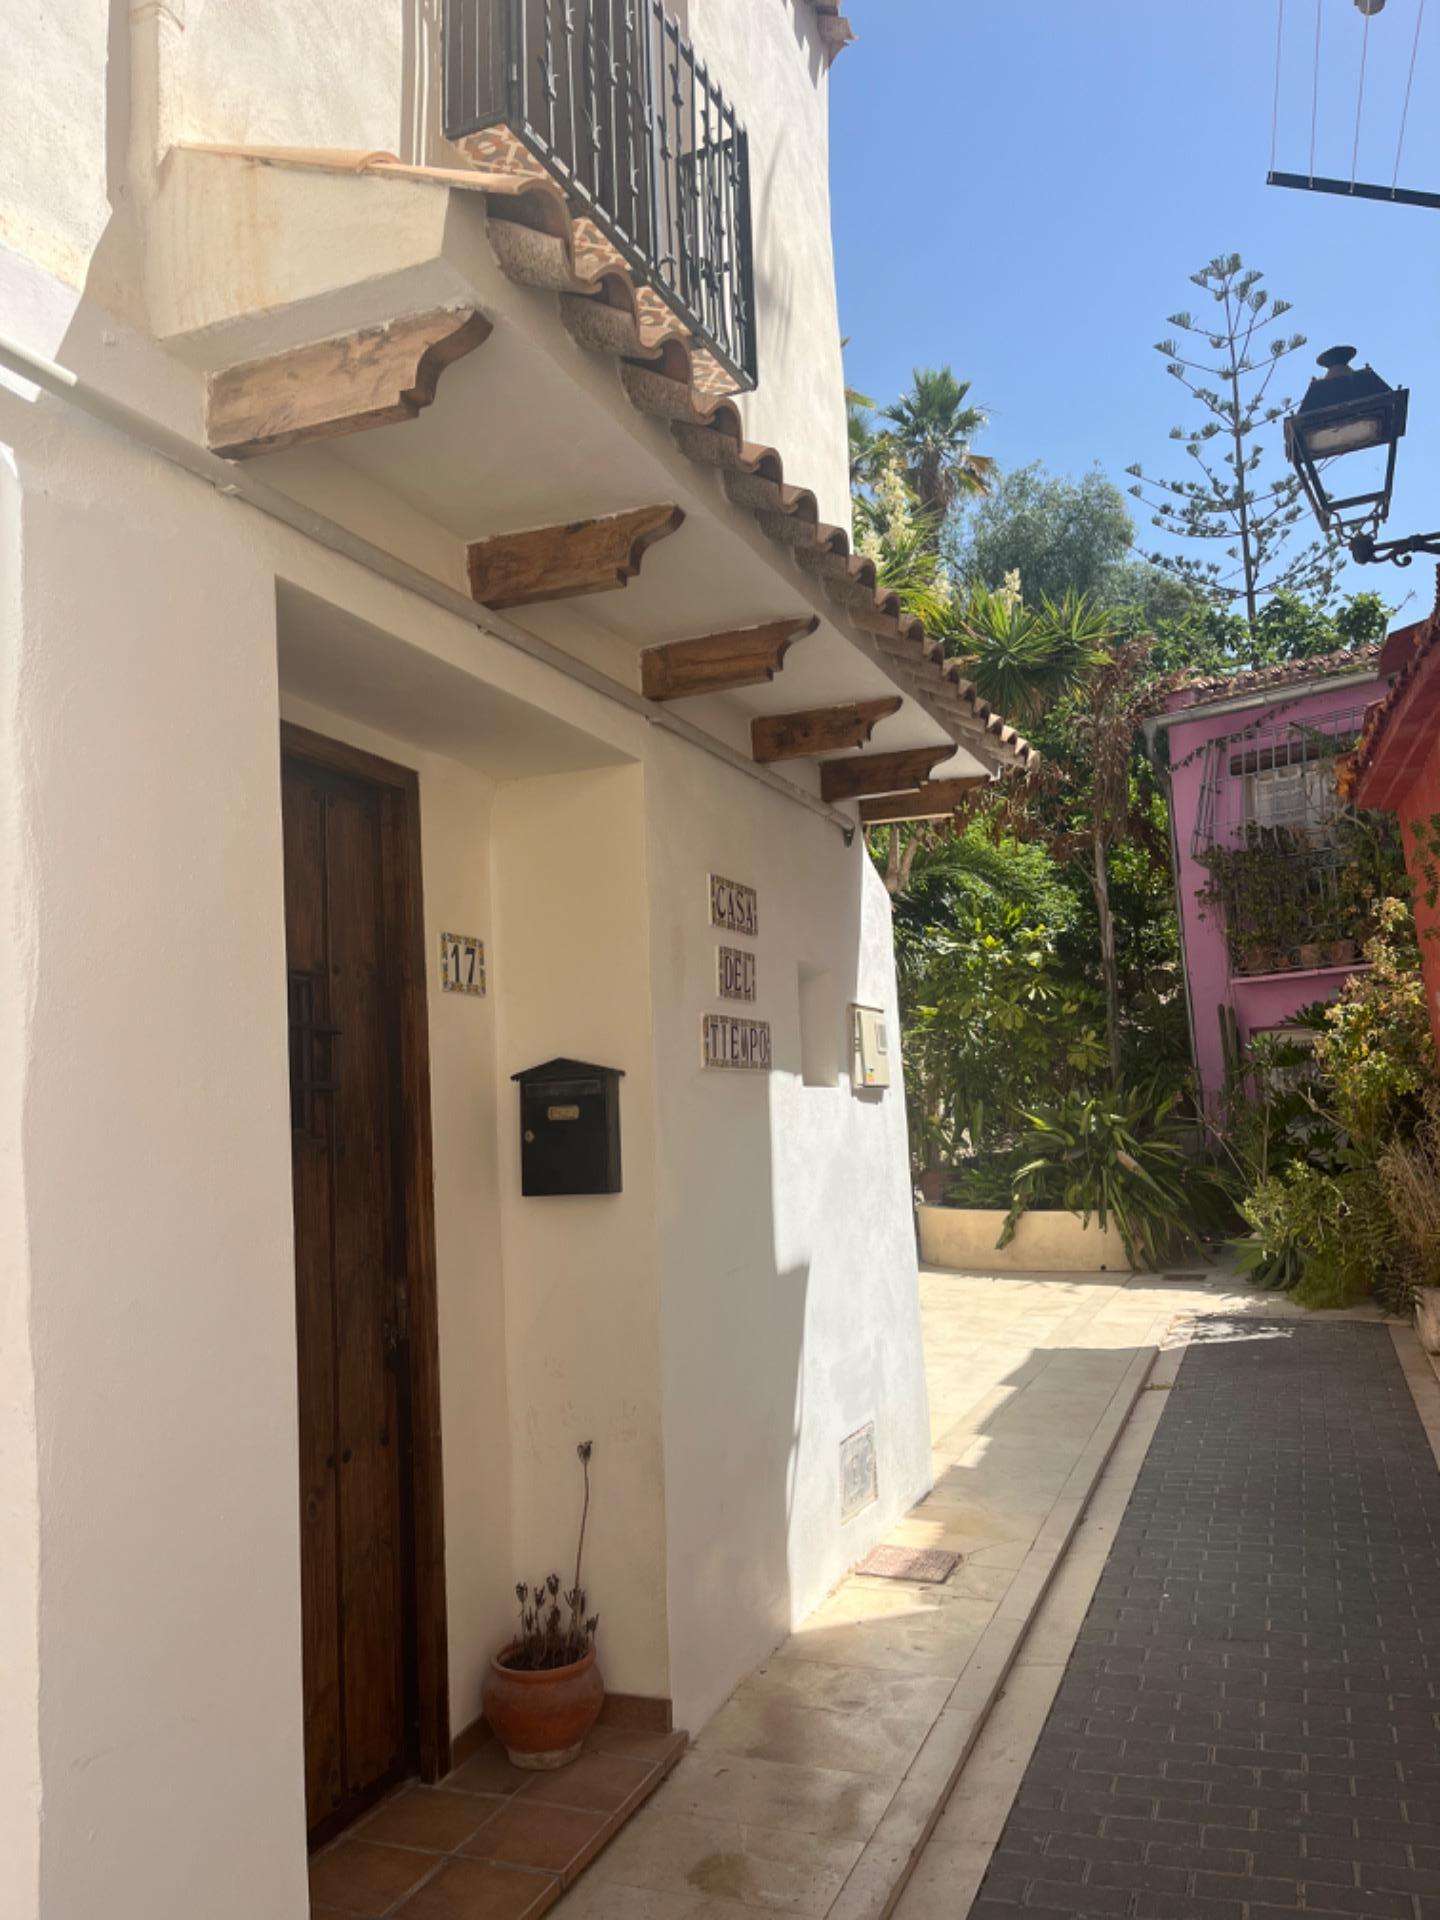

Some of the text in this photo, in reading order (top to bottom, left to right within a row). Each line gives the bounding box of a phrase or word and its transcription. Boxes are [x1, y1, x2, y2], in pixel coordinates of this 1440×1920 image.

[715, 885, 754, 930] CASA
[451, 944, 476, 984] 17
[724, 955, 752, 993] DEL
[710, 1023, 767, 1062] TIEMPO
